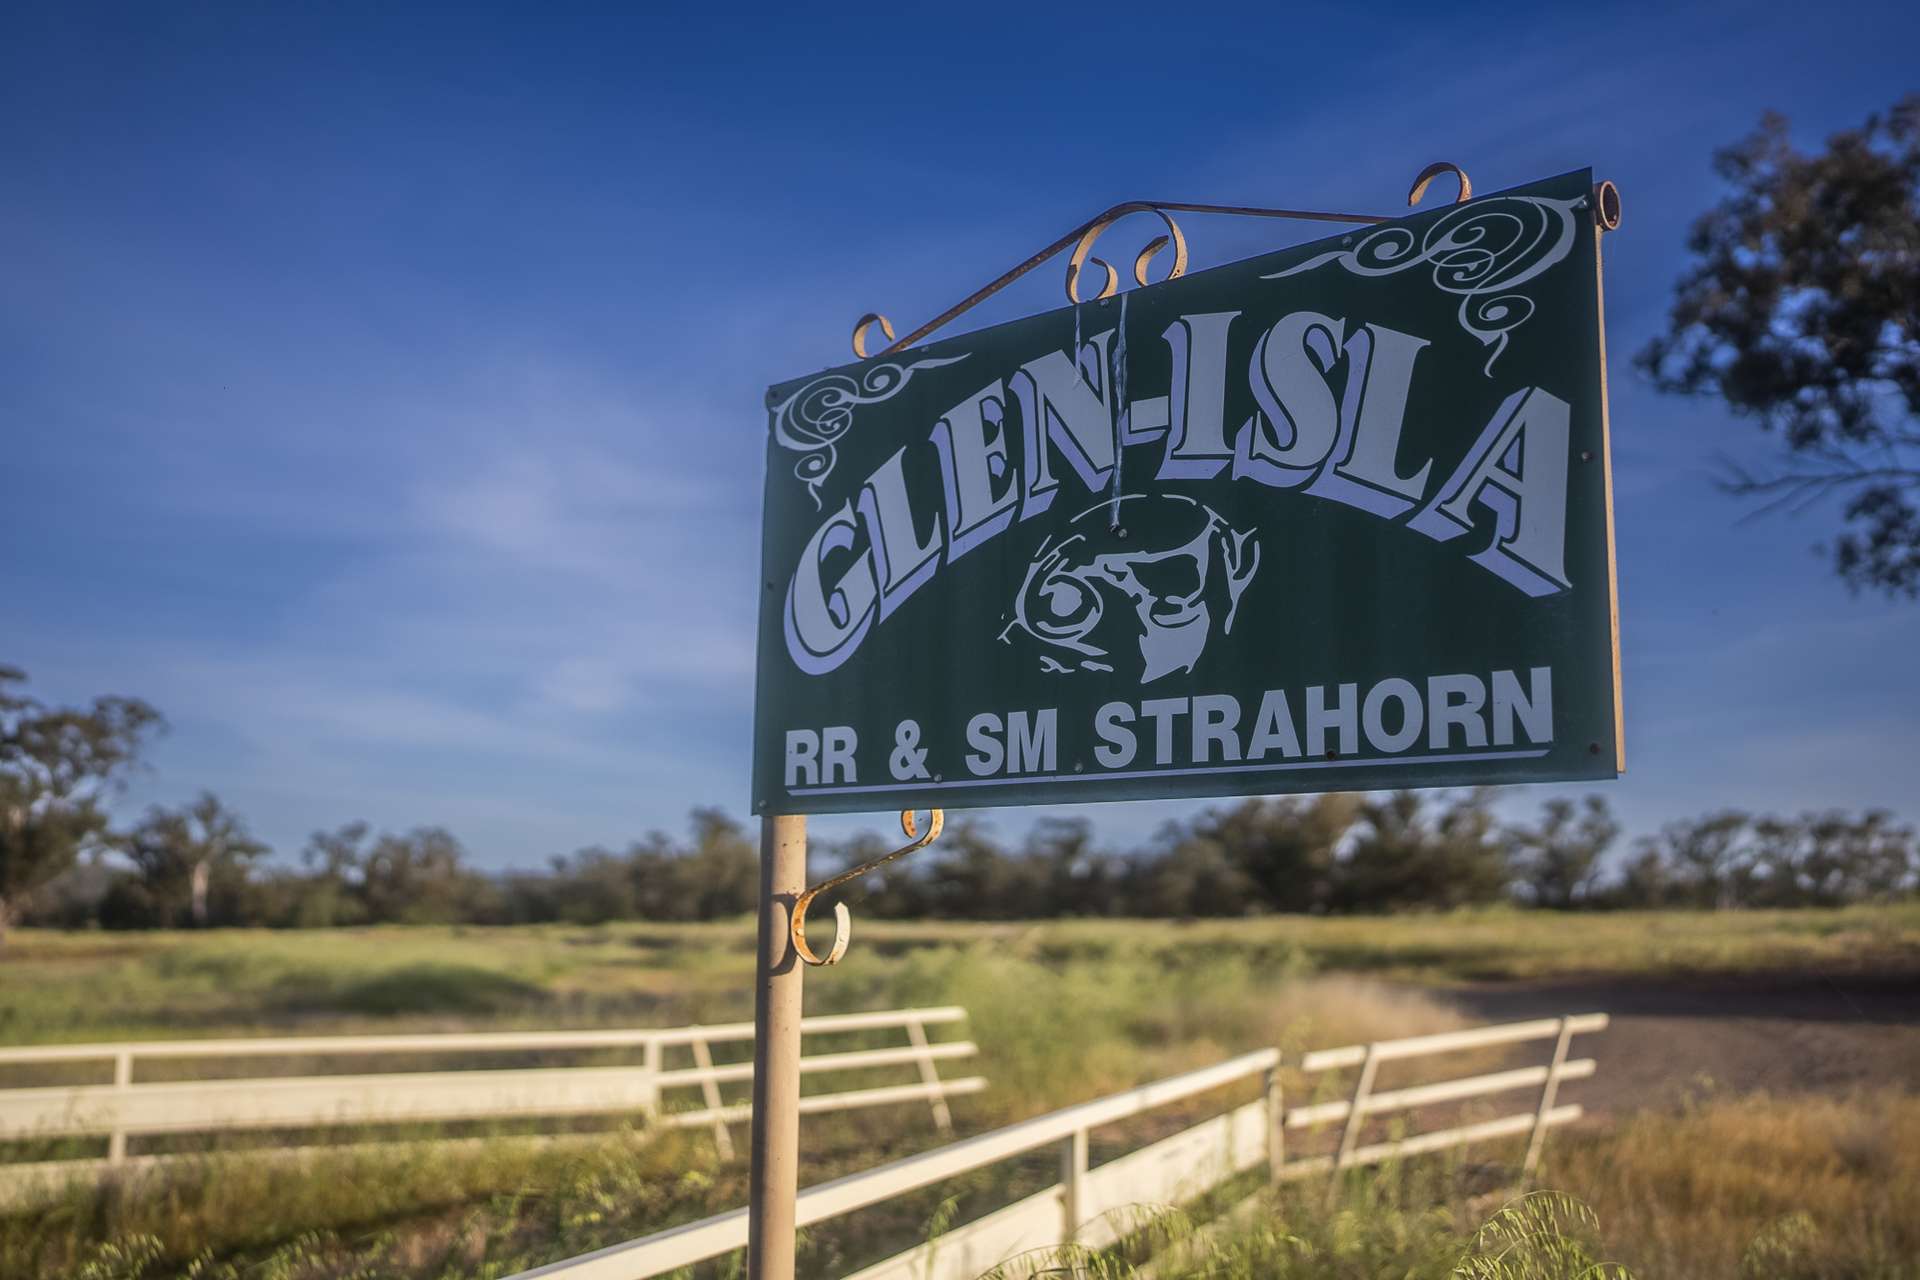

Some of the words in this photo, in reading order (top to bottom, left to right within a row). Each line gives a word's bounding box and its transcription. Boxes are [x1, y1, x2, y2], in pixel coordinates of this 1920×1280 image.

[783, 311, 1573, 675] GLEN-ISLA
[784, 726, 857, 785] RR
[889, 719, 930, 779] &
[966, 709, 1058, 775] SM
[1094, 667, 1554, 769] STRAHORN
